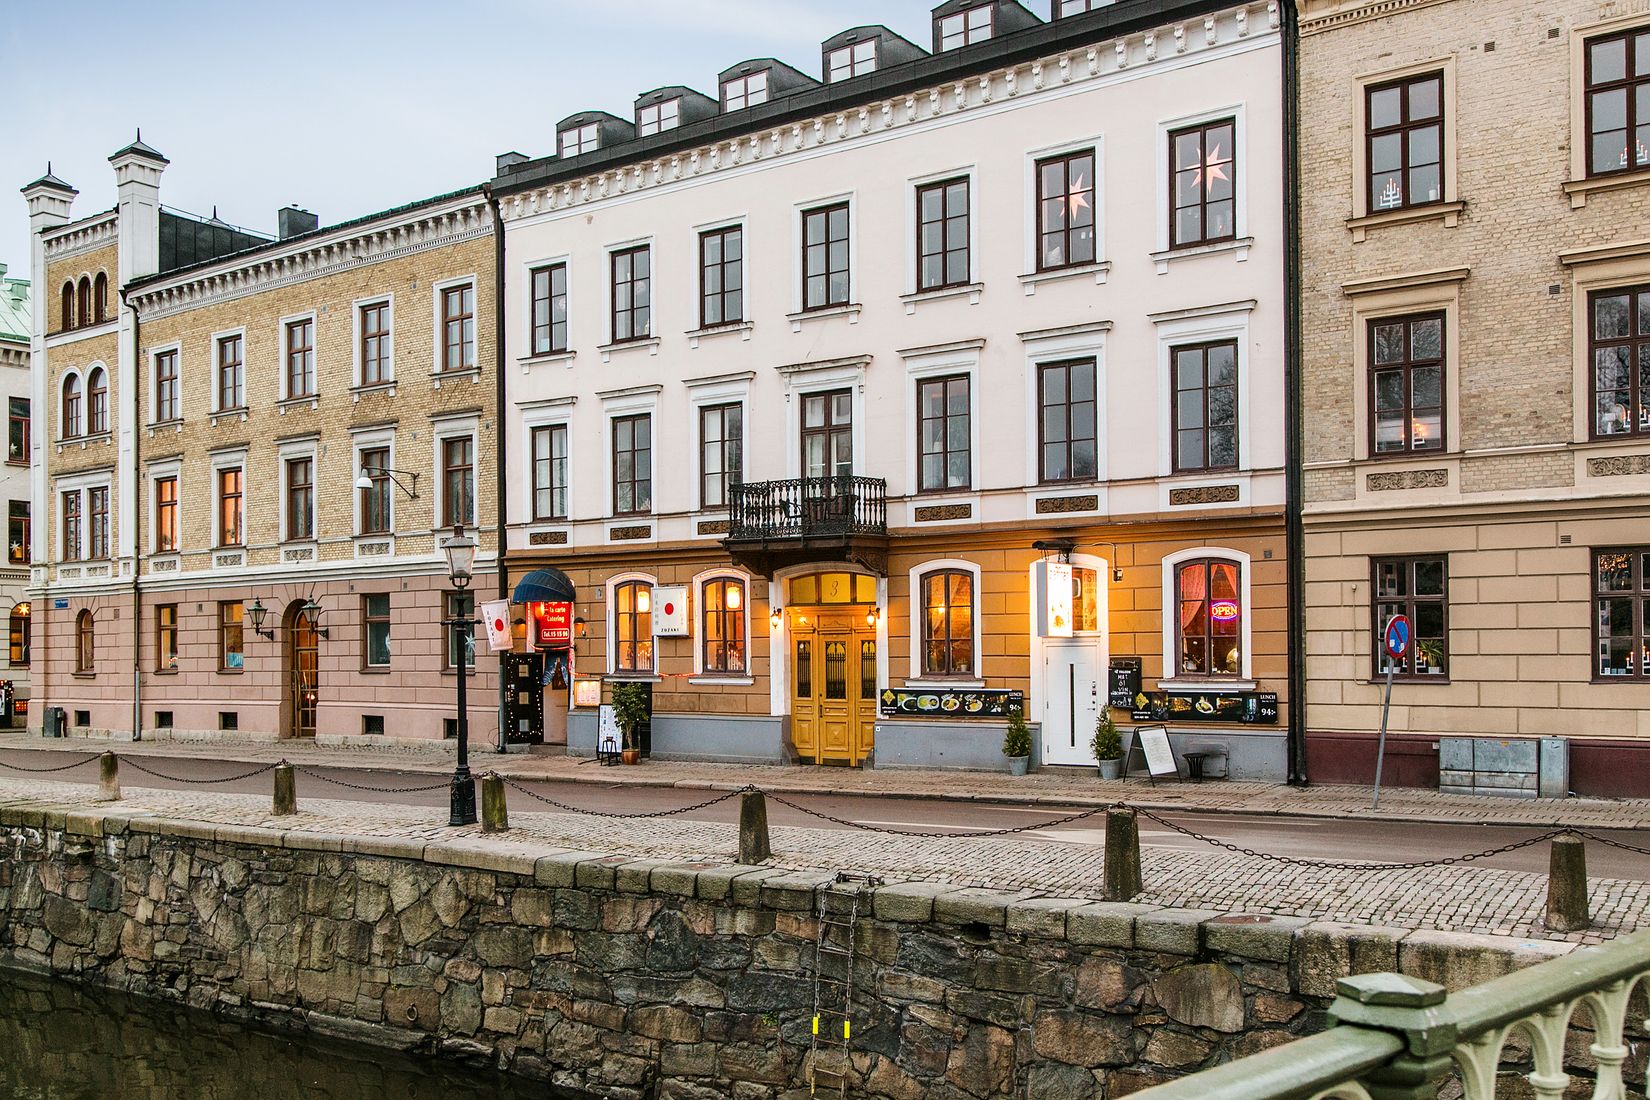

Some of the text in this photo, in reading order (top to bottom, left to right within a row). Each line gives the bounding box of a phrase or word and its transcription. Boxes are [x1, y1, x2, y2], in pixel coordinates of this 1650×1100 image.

[830, 580, 839, 598] 3
[1211, 605, 1238, 616] OPEN
[546, 615, 565, 624] Catering
[1261, 707, 1276, 716] 94:-
